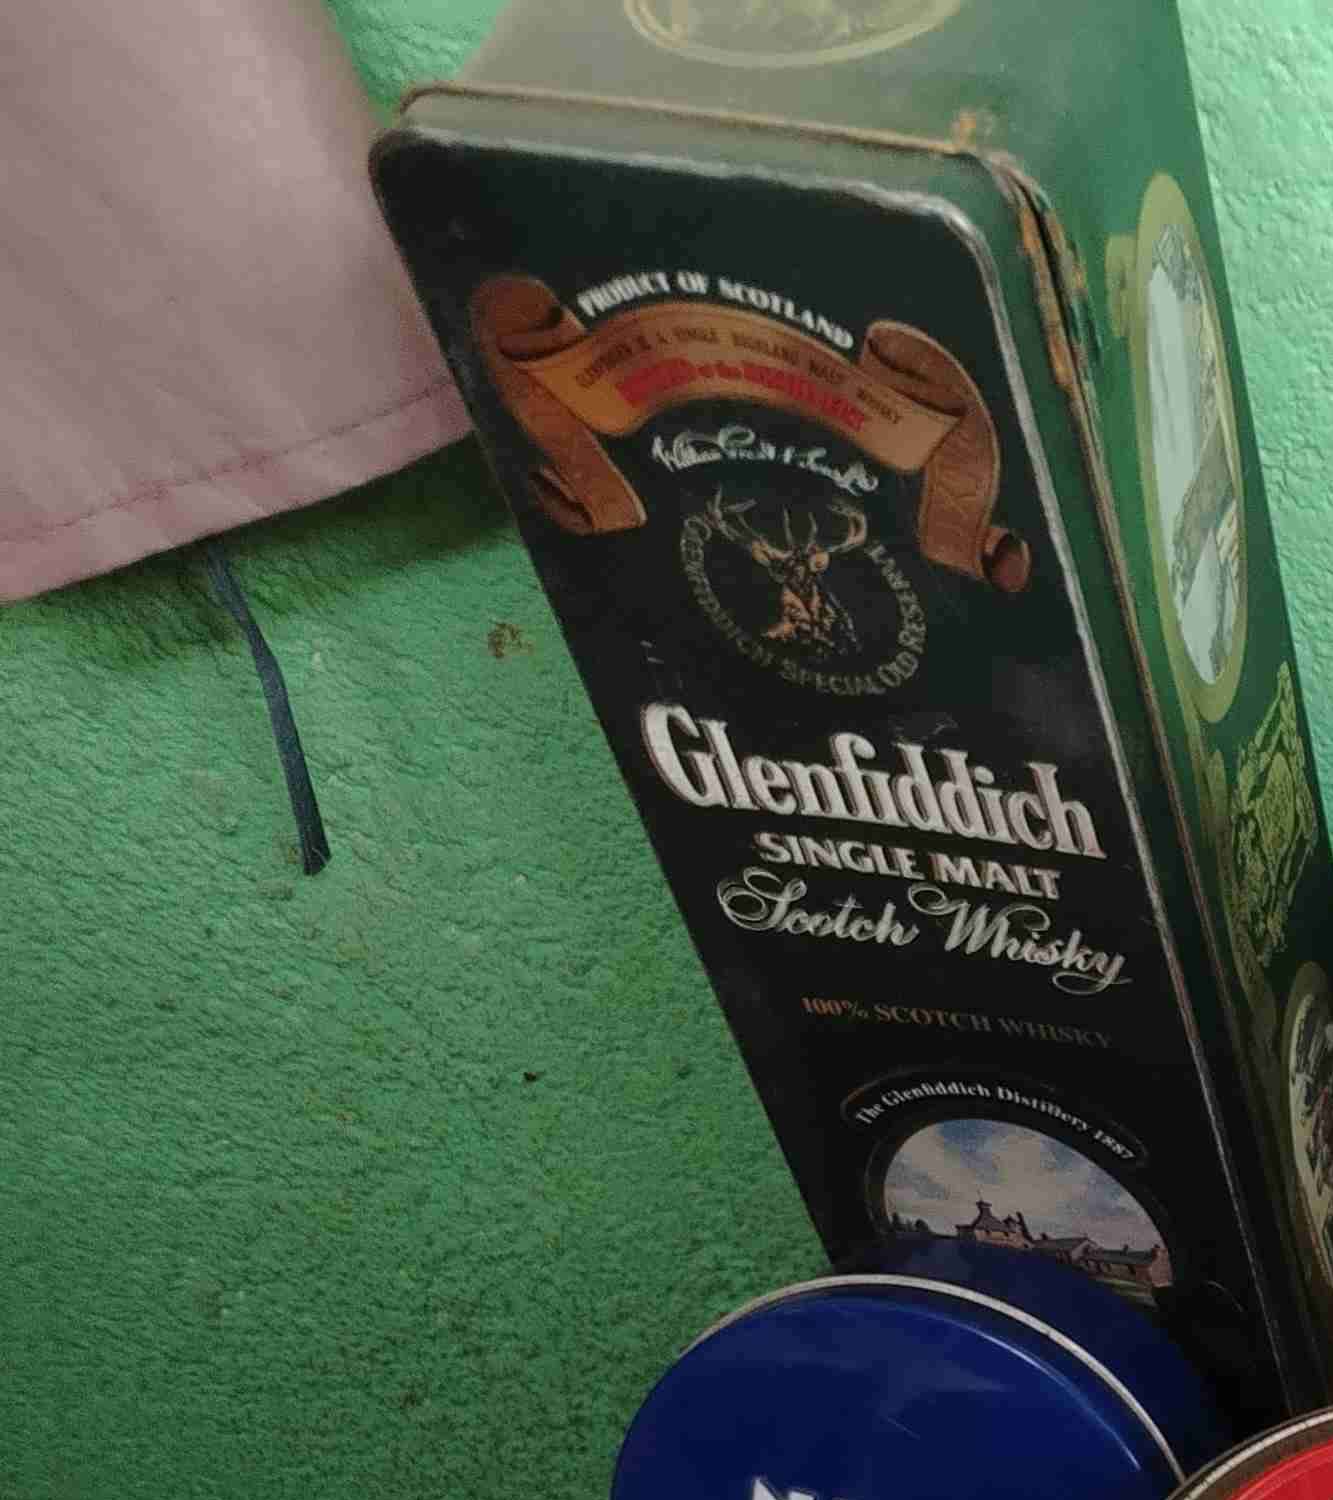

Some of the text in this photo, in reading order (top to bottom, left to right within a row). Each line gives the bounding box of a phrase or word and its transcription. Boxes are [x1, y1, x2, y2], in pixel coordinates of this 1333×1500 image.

[577, 270, 854, 349] PRODUCT OF SCOTLAND
[641, 702, 1107, 859] Glenfiddich
[753, 830, 1061, 900] SINGLE MALT
[716, 865, 1133, 995] Scotch Whisky
[801, 995, 1113, 1049] 100% SCOTCH WHISKY
[855, 1080, 1136, 1162] The Glenfiddich Distillery 1887
